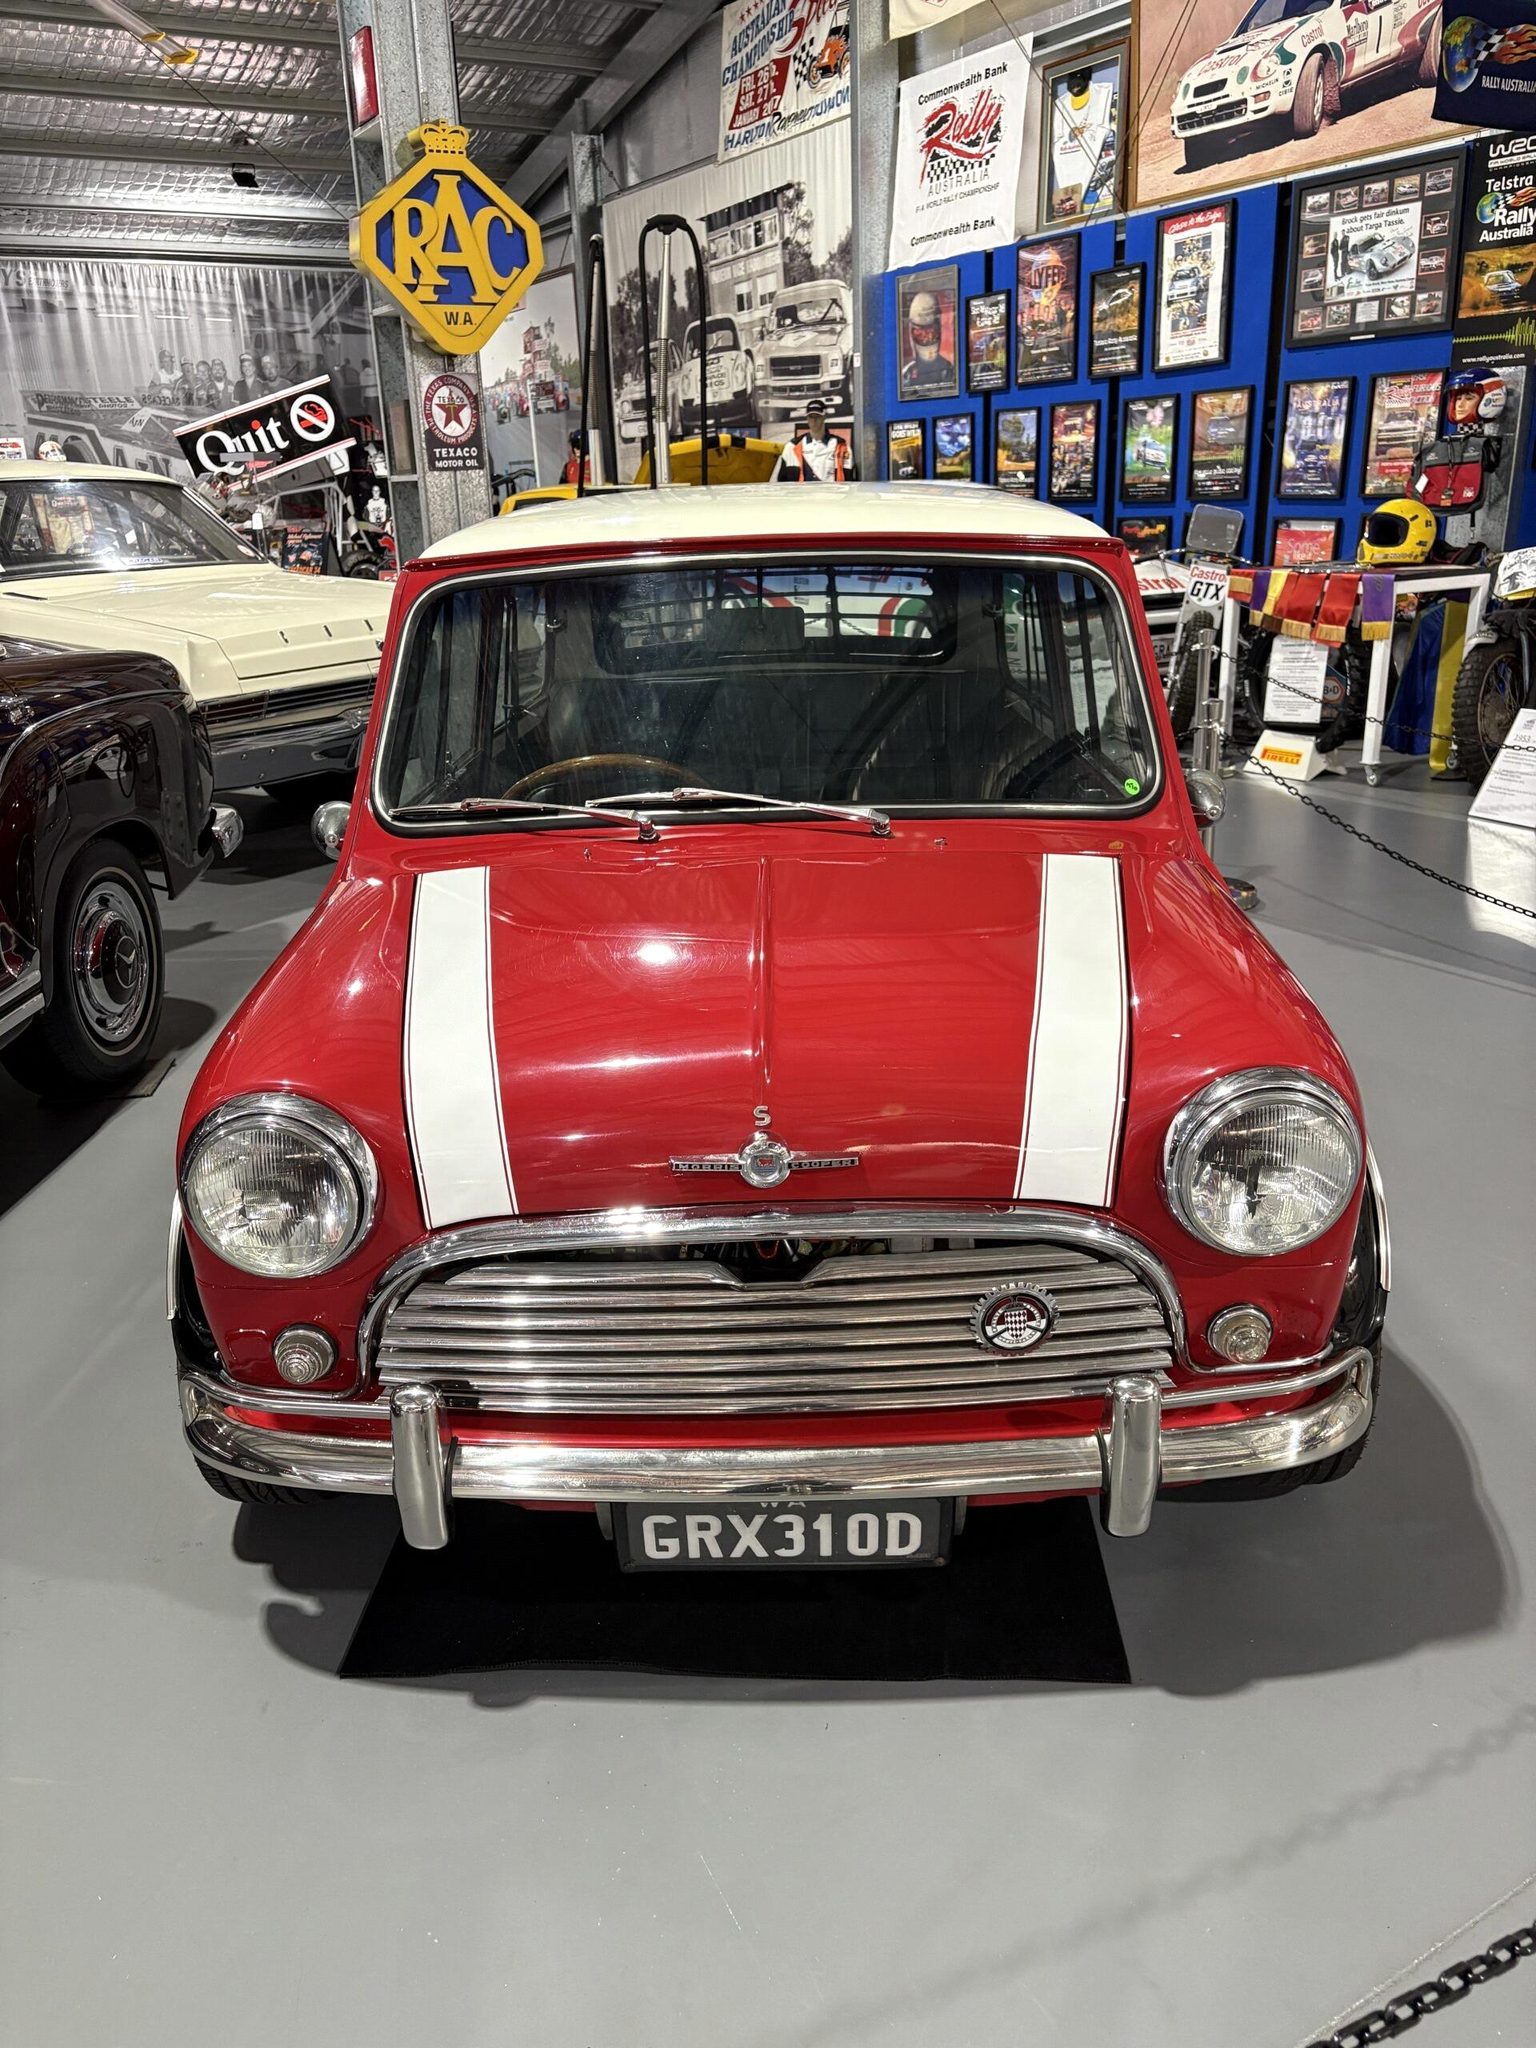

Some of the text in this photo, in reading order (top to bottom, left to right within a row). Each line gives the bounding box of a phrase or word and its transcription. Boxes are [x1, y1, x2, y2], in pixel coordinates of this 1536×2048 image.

[1301, 23, 1325, 47] Castrol
[918, 62, 1008, 106] Commonwealth Bank
[1256, 79, 1279, 90] MICHELIN
[1482, 75, 1536, 92] RALLY AUSTRALIA
[917, 87, 1003, 188] Rally
[928, 168, 990, 197] AUSTRALIA
[1486, 175, 1533, 192] Telstra
[1342, 207, 1410, 225] Brock gets fair dinkum
[1494, 206, 1536, 227] Rally
[910, 216, 995, 247] Commonwealth Bank
[1346, 225, 1363, 234] about
[1365, 222, 1382, 231] Targa
[1479, 223, 1533, 243] Australia
[393, 174, 522, 303] RAC
[445, 311, 477, 326] W.A.
[1462, 353, 1526, 363] www.rallyaustralia.com
[427, 380, 443, 398] TEXAS
[444, 376, 470, 395] COMPANY
[196, 417, 289, 476] Quit
[433, 447, 478, 457] TEXACO
[435, 459, 478, 468] MOTOR OIL
[1137, 577, 1187, 591] strol
[1190, 566, 1226, 583] Castro
[1190, 580, 1225, 601] GTX
[753, 1105, 771, 1127] S
[678, 1158, 855, 1171] MORRIS COOPER
[642, 1512, 922, 1560] GRX310D
